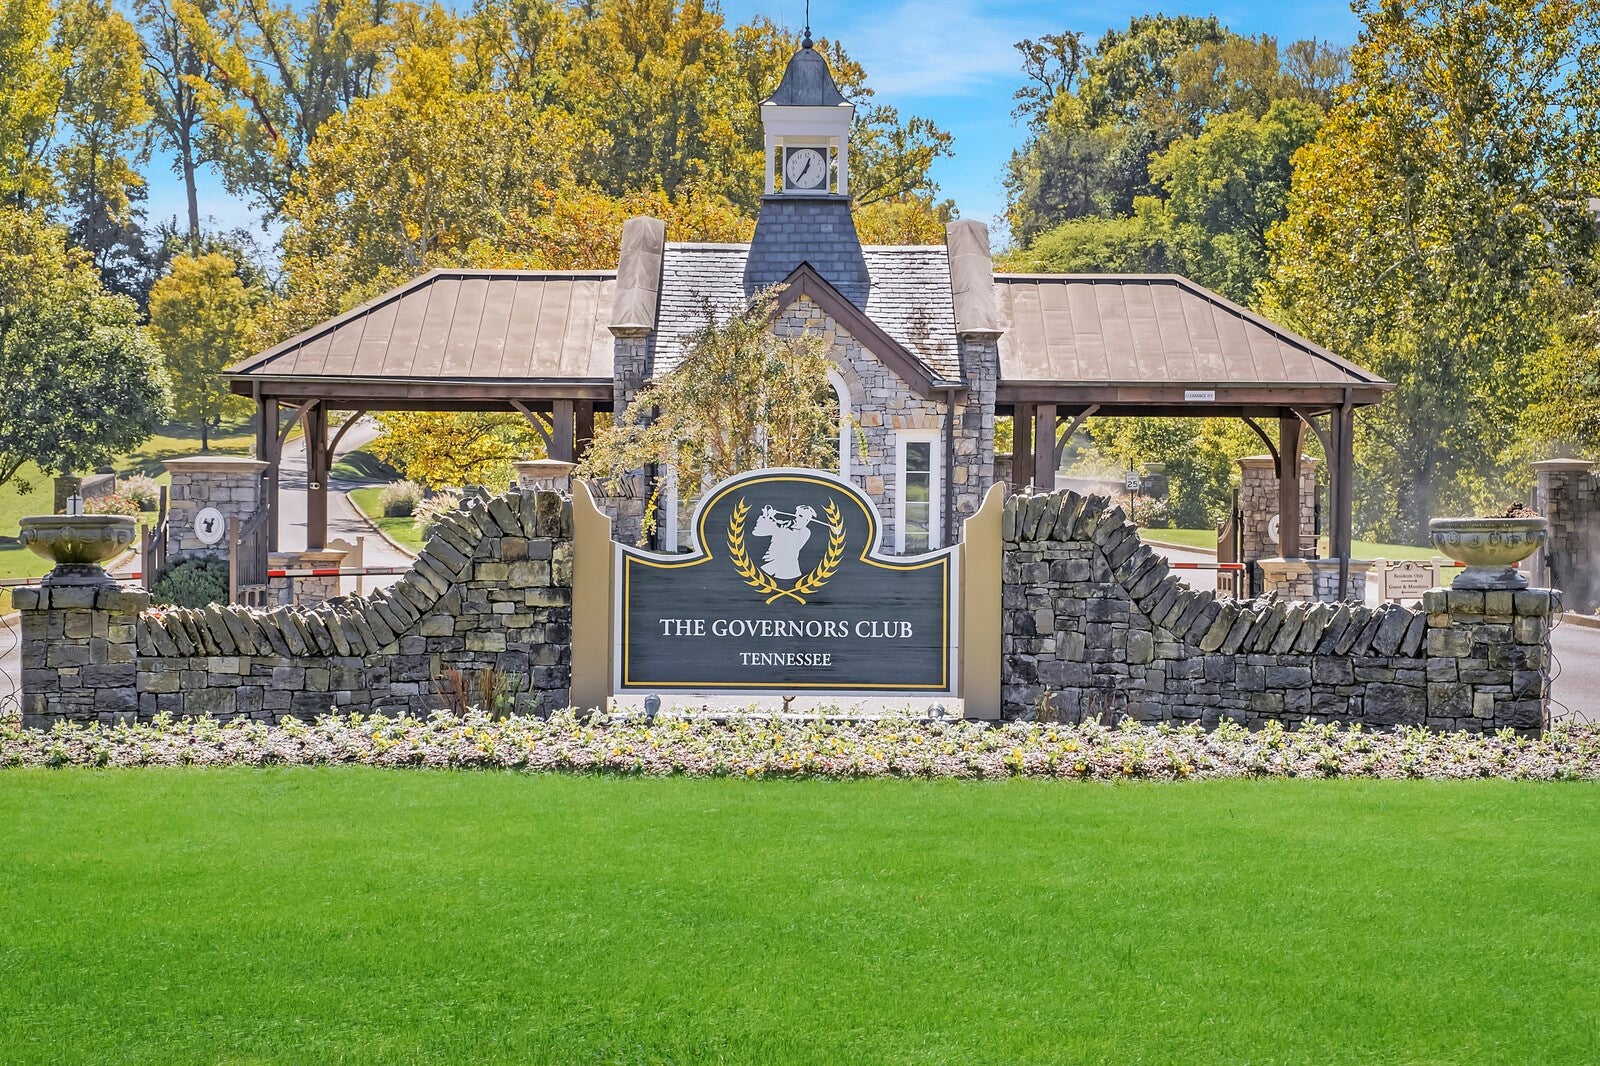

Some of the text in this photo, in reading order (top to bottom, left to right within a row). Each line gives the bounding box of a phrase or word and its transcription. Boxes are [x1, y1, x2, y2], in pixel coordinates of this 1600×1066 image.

[659, 618, 913, 638] THE GOVERNORS CLUB
[740, 652, 832, 666] TENNESSEE
